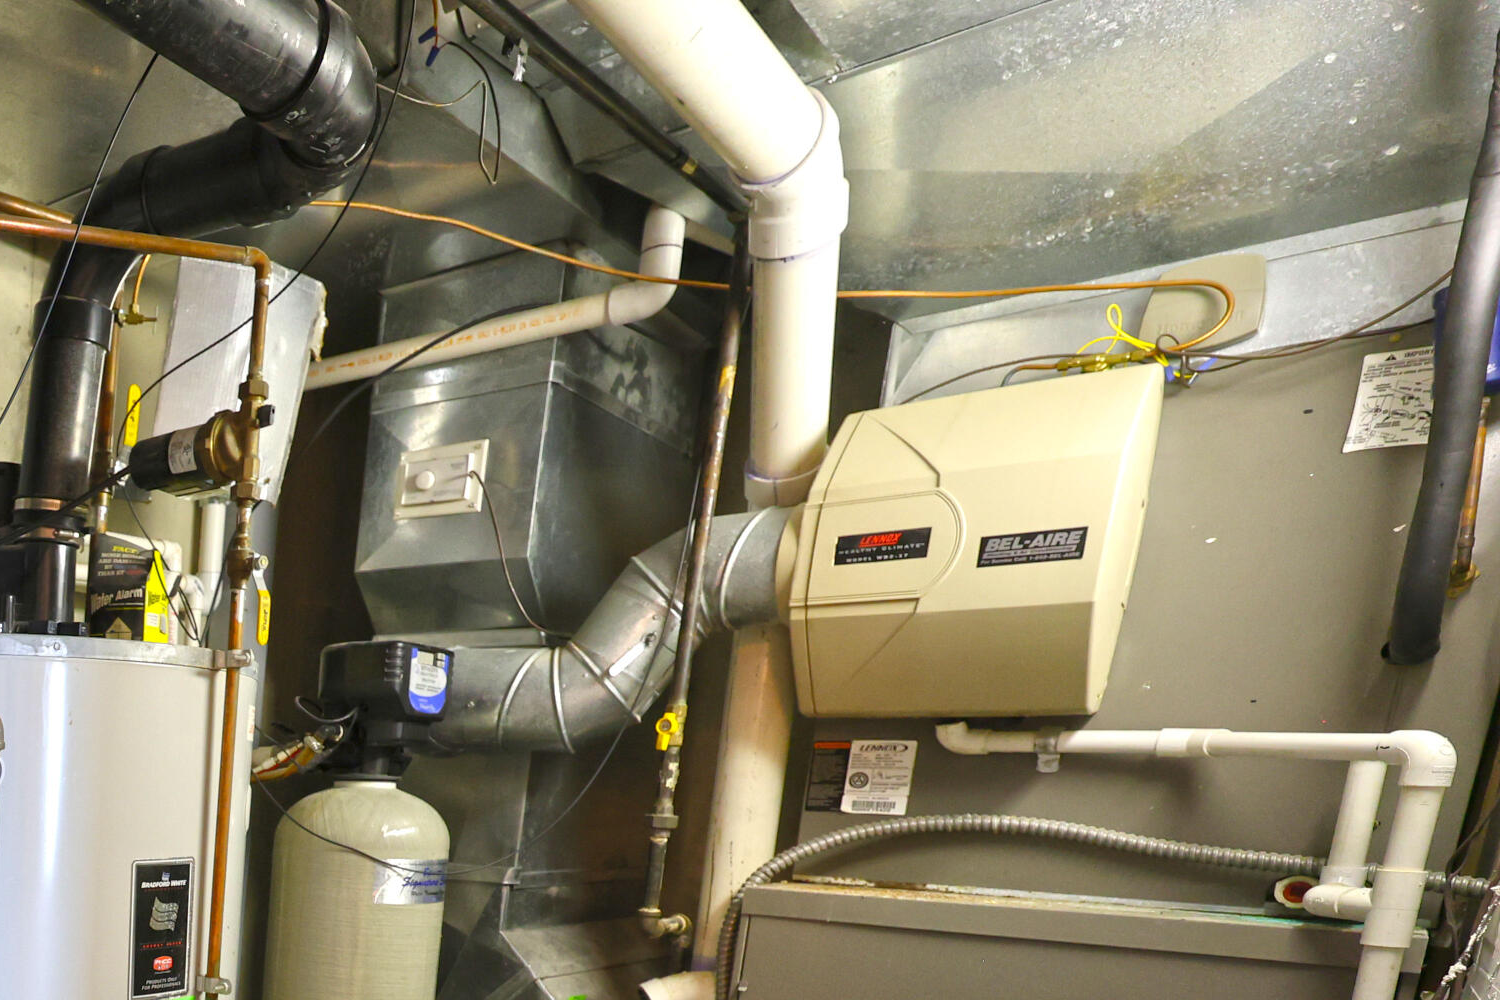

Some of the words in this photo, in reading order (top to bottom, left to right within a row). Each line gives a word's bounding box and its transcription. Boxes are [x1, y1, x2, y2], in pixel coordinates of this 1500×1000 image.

[860, 532, 902, 546] LENNOX
[985, 530, 1084, 552] BEL-AIRE
[115, 588, 143, 601] Alarm
[860, 744, 897, 752] LENNOX
